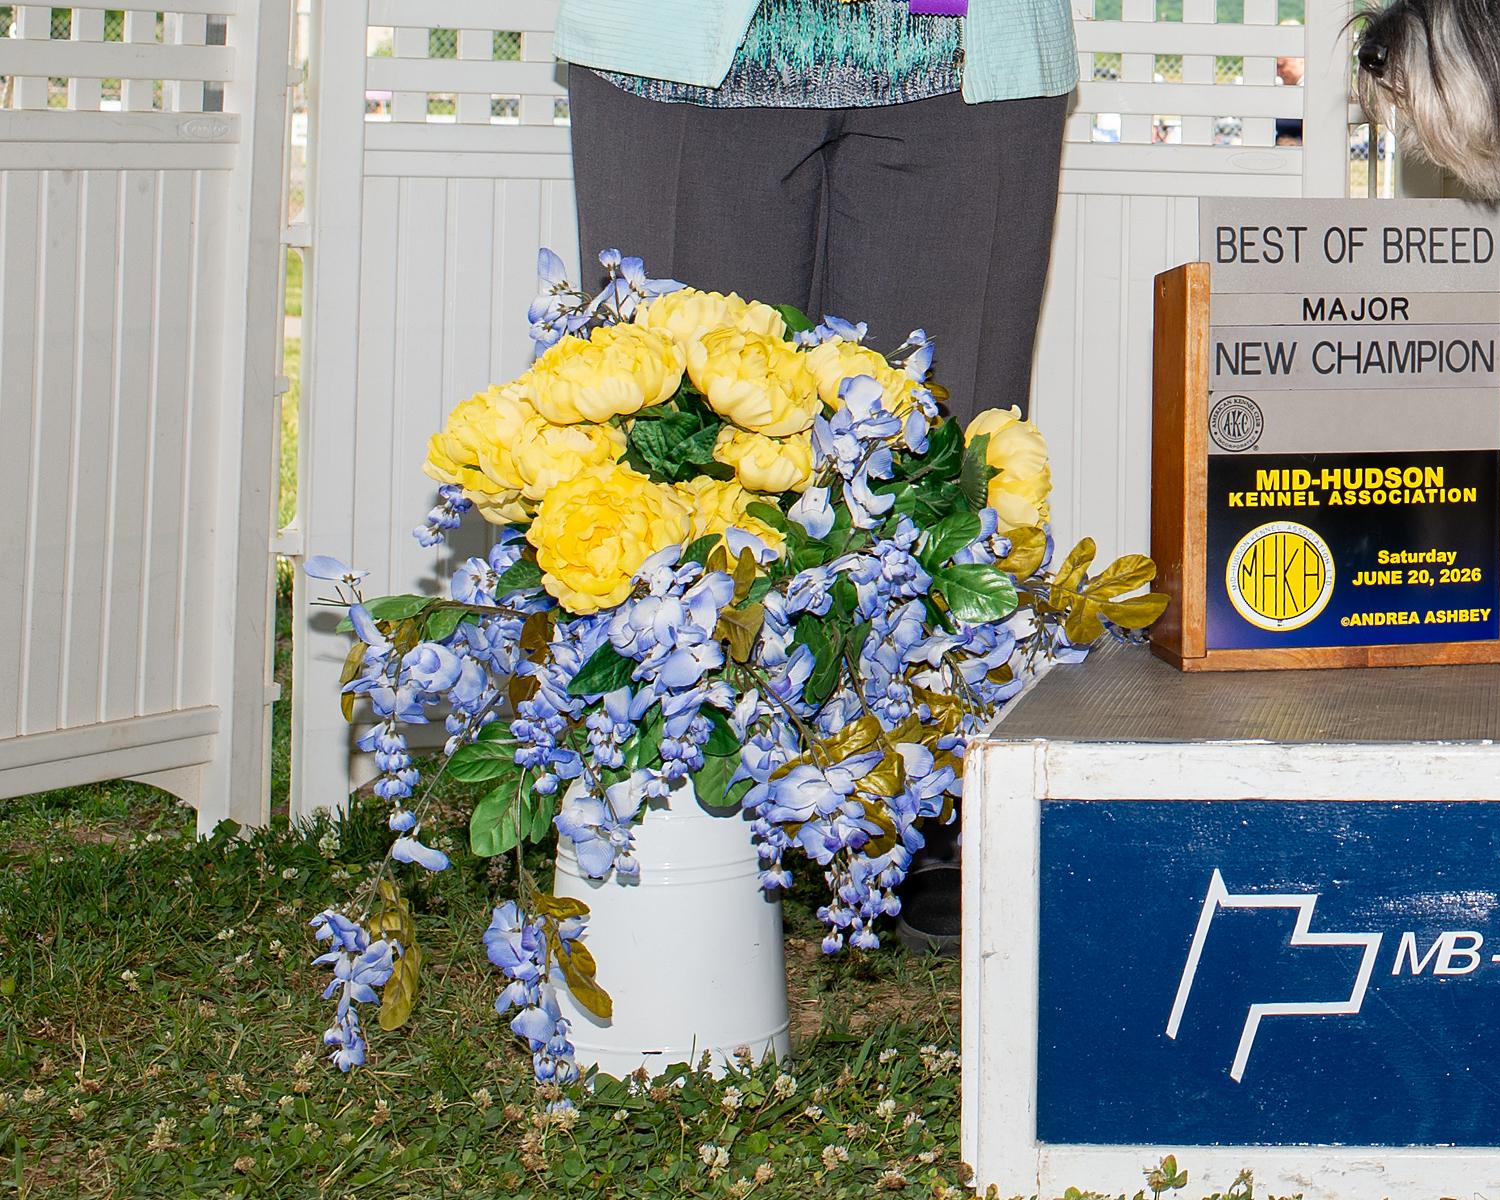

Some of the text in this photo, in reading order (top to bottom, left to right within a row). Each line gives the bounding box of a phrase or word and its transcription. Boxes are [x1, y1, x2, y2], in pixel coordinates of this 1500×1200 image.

[1216, 226, 1494, 264] BEST OF BREED
[1302, 297, 1409, 321] MAJOR
[1216, 339, 1495, 376] NEW CHAMPION
[1211, 399, 1232, 429] AMERICAN
[1233, 398, 1255, 411] KENNEL
[1256, 466, 1444, 491] MID-HUDSON
[1228, 487, 1477, 507] KENNEL ASSOCIATION
[1230, 540, 1250, 591] MID-HUDSON
[1250, 525, 1281, 541] KENNEL
[1287, 525, 1330, 565] ASSOCIATION
[1377, 549, 1457, 565] Saturday
[1242, 534, 1320, 617] MHKA
[1352, 567, 1482, 587] JUNE 20, 2026
[1424, 608, 1492, 624] ASHBEY
